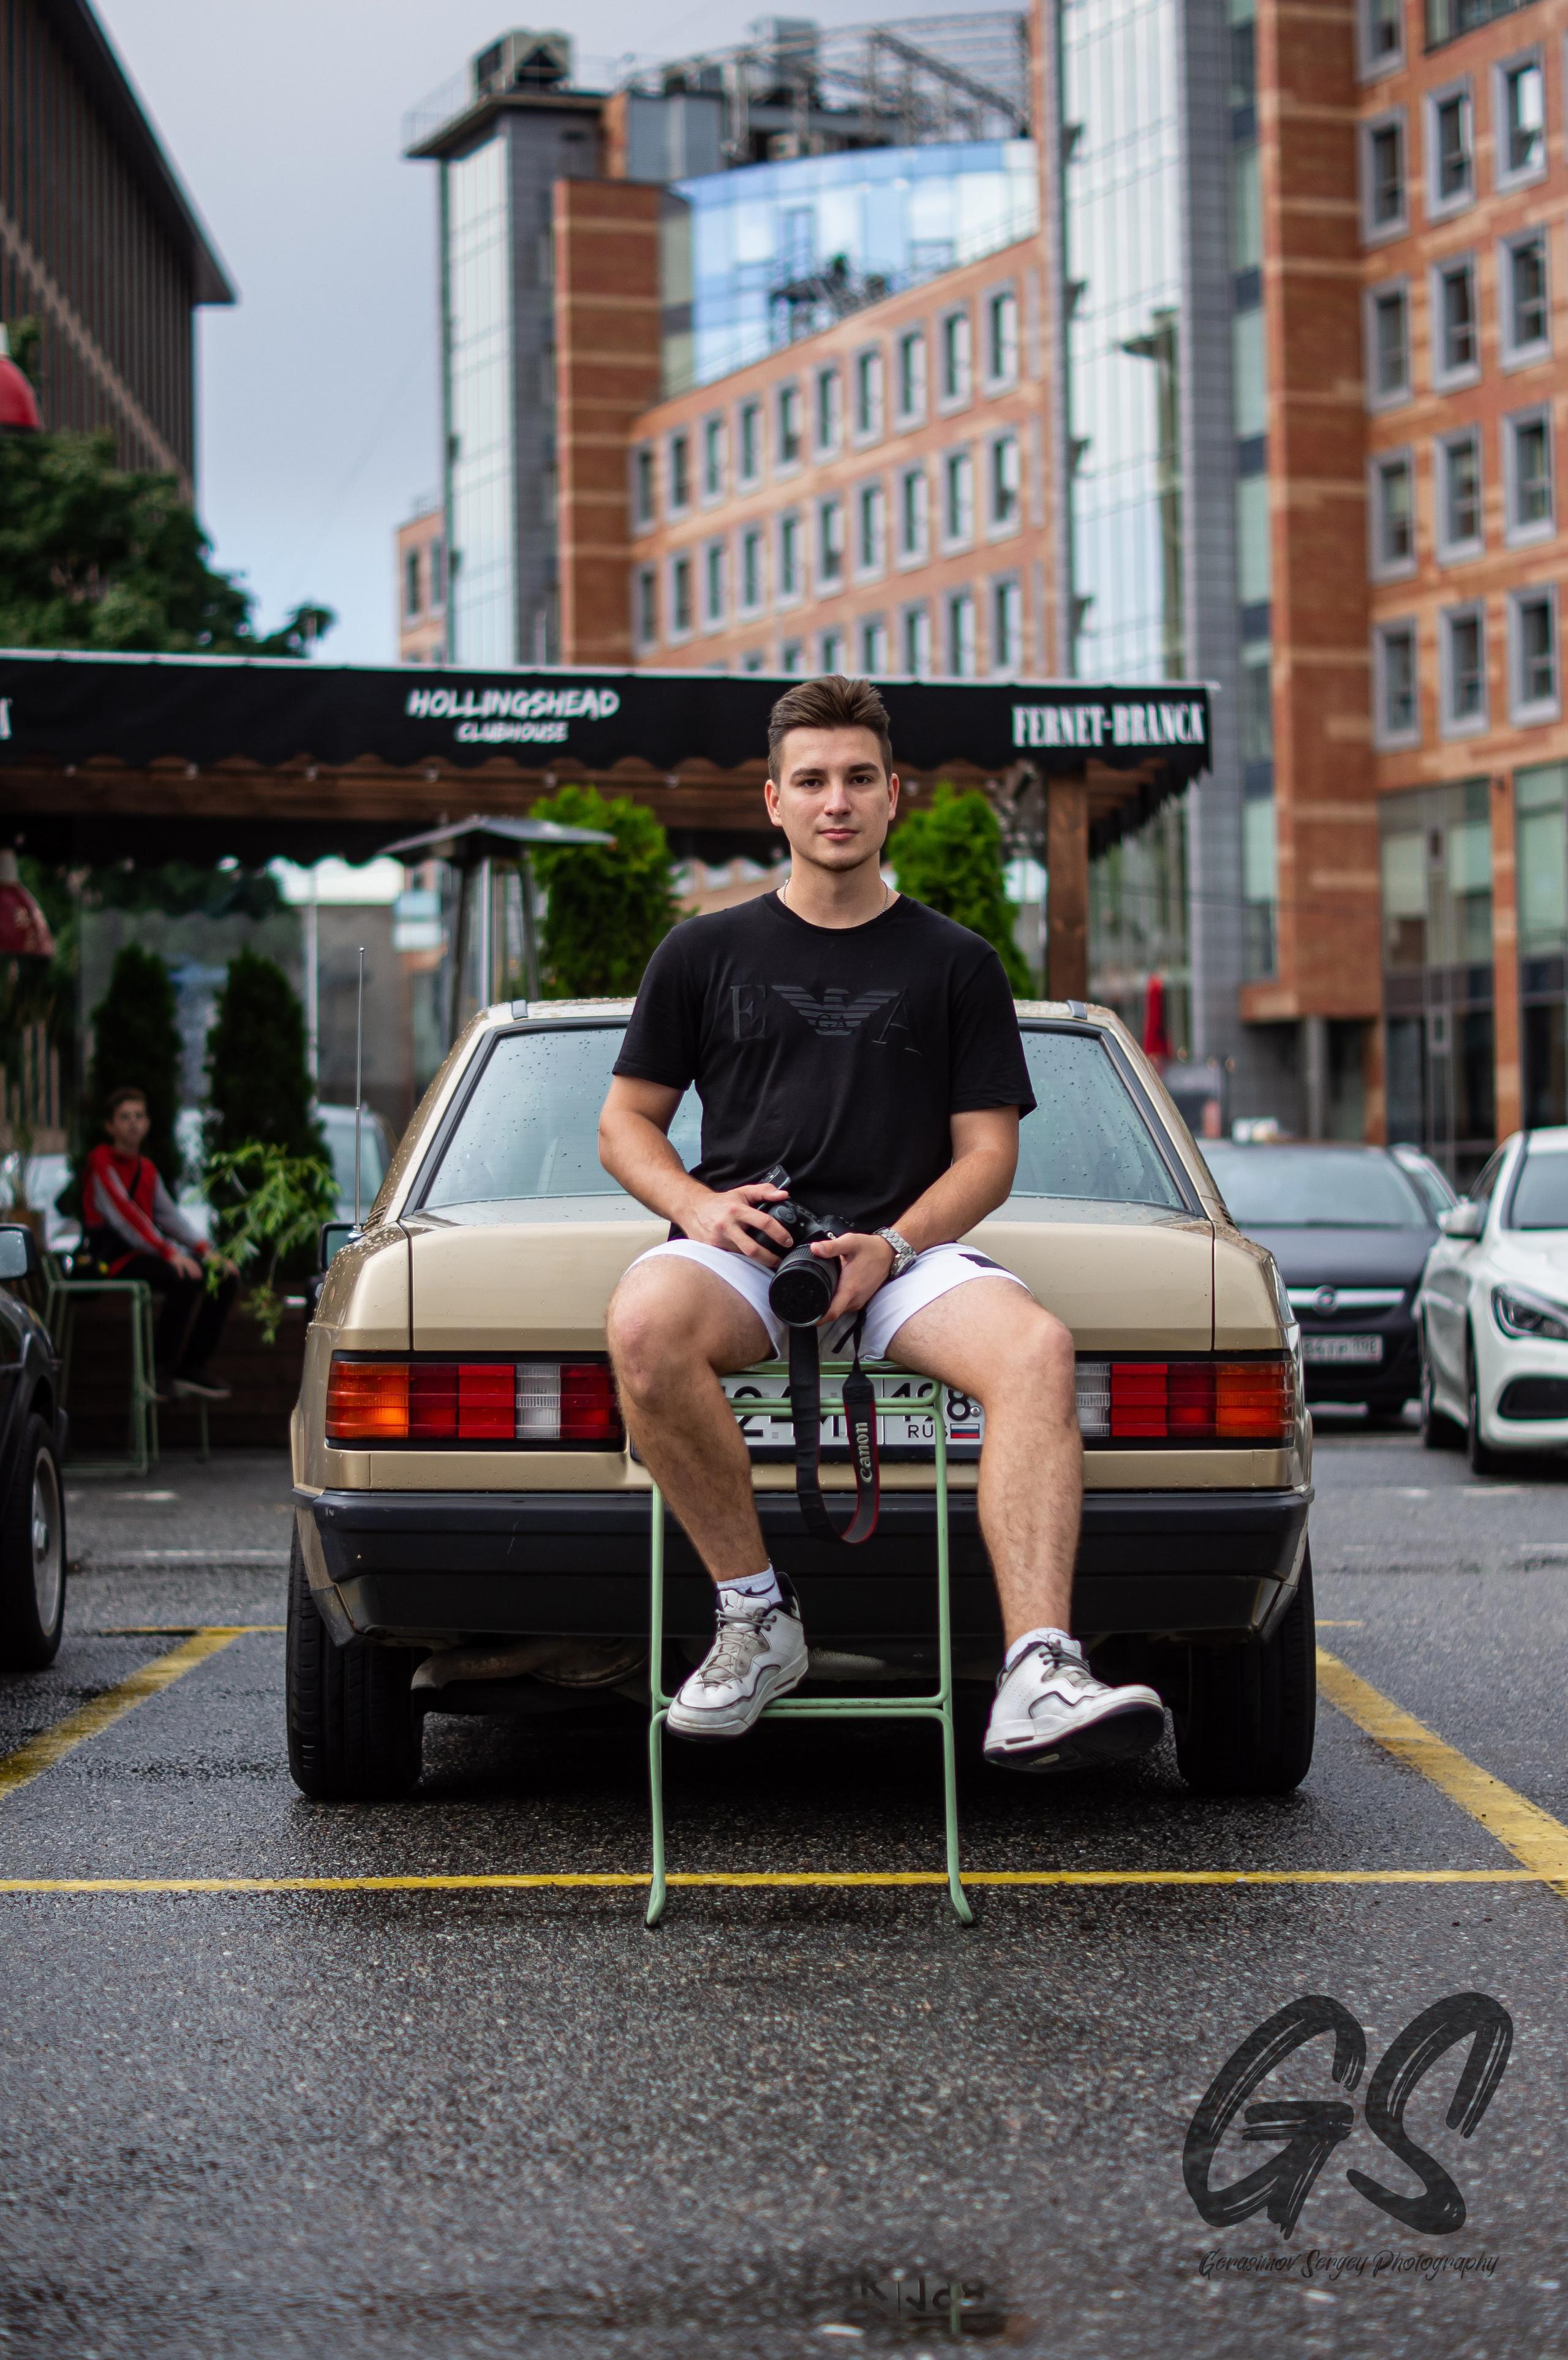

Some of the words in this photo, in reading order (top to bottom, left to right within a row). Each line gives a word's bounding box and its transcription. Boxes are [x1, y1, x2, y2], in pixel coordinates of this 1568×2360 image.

[407, 688, 620, 720] HOLLINGSHEAD
[456, 721, 569, 743] CLUBHOUSE
[1014, 703, 1205, 746] FERNET-BRANCA
[816, 1013, 851, 1032] GA
[908, 1424, 948, 1439] RU
[855, 1422, 873, 1483] Canon
